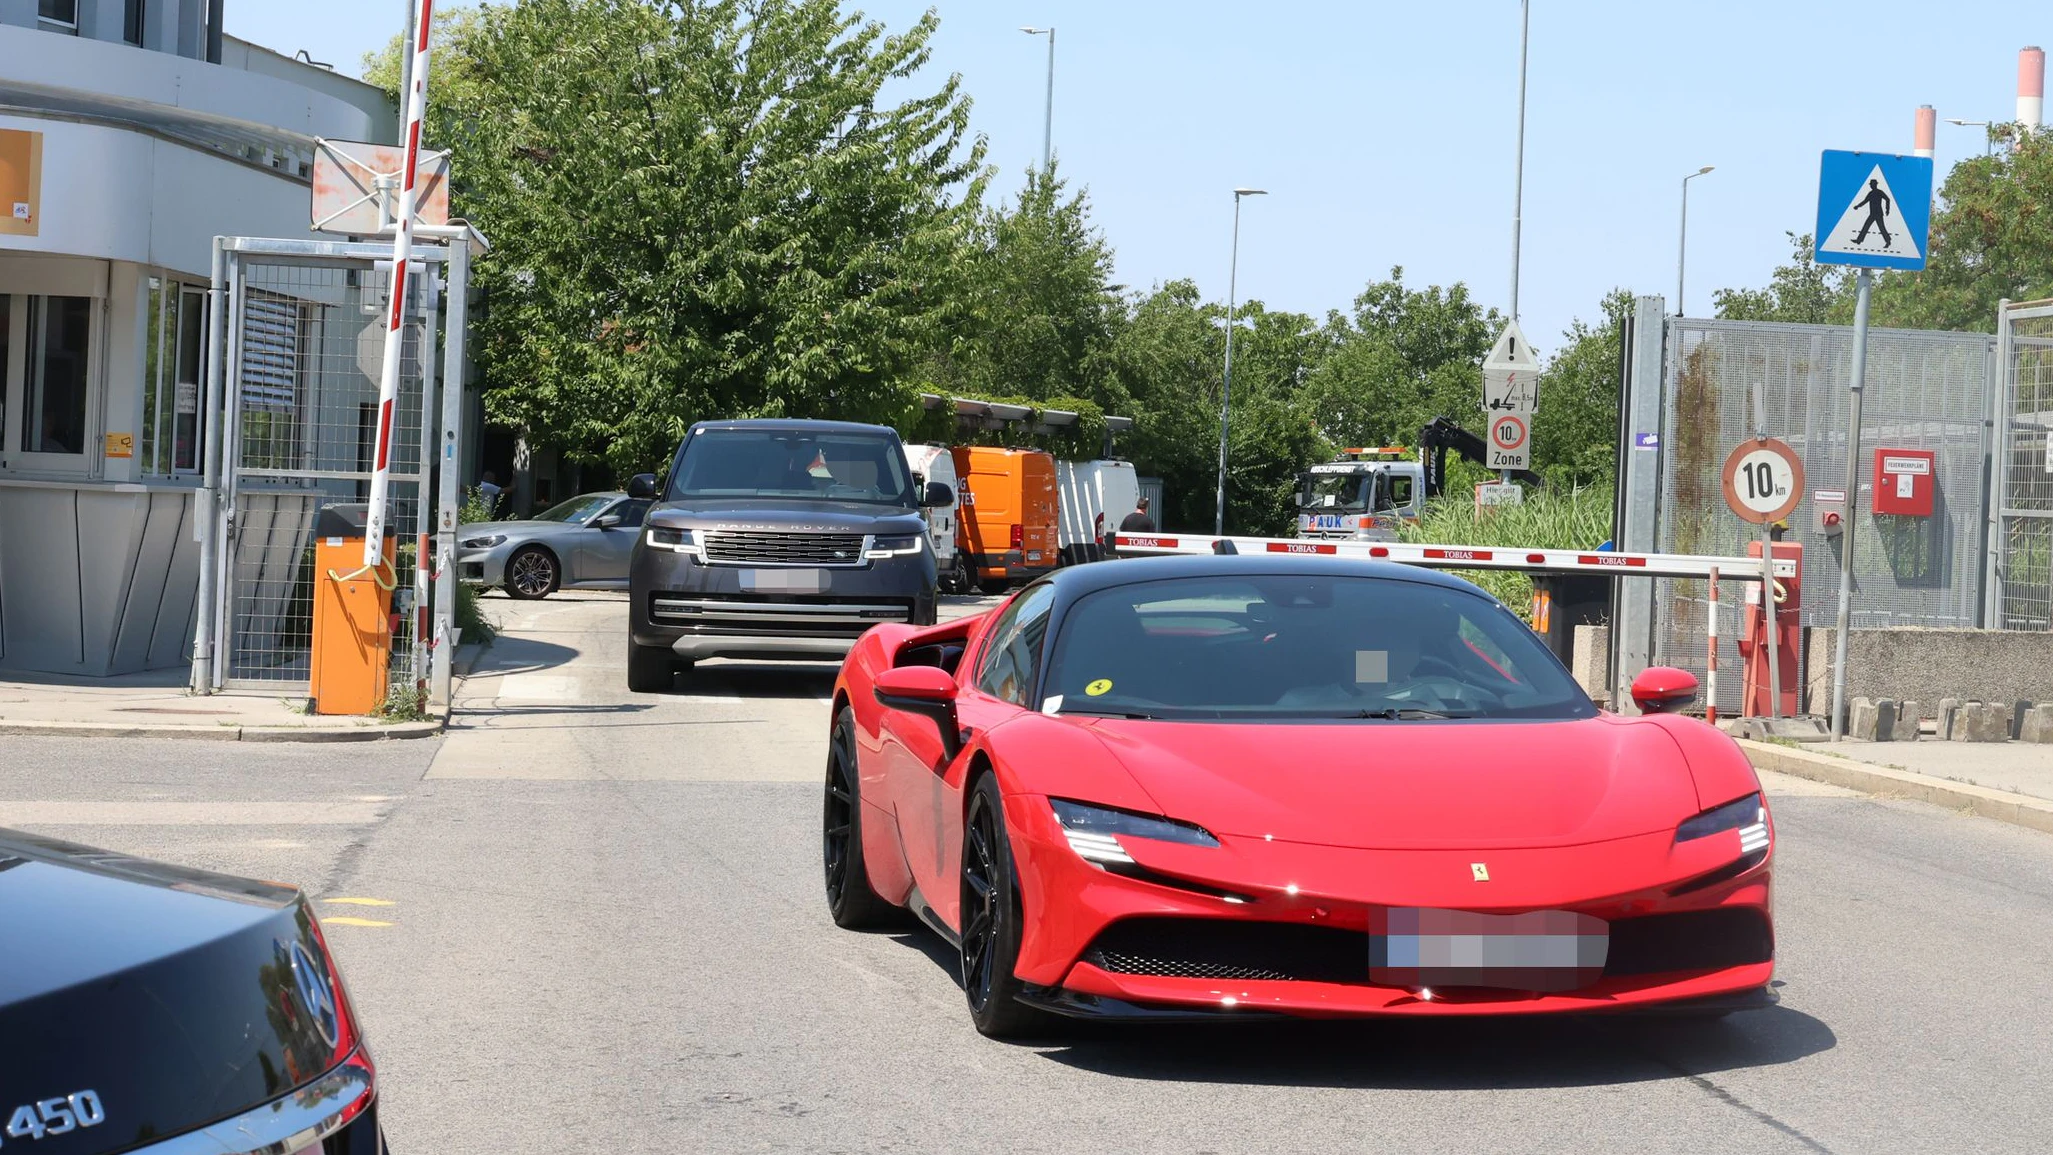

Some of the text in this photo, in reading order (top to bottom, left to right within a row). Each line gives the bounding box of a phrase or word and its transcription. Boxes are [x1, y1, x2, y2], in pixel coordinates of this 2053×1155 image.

[1500, 426, 1512, 441] 10
[1494, 451, 1522, 466] Zone
[1742, 461, 1786, 499] 10 km
[1308, 516, 1342, 528] PAUK
[1127, 538, 1158, 546] TOBIAS
[1286, 545, 1317, 553] TOBIAS
[1444, 550, 1473, 559] TOBIAS
[1597, 556, 1627, 565] TOBIAS
[7, 1089, 105, 1140] 450
